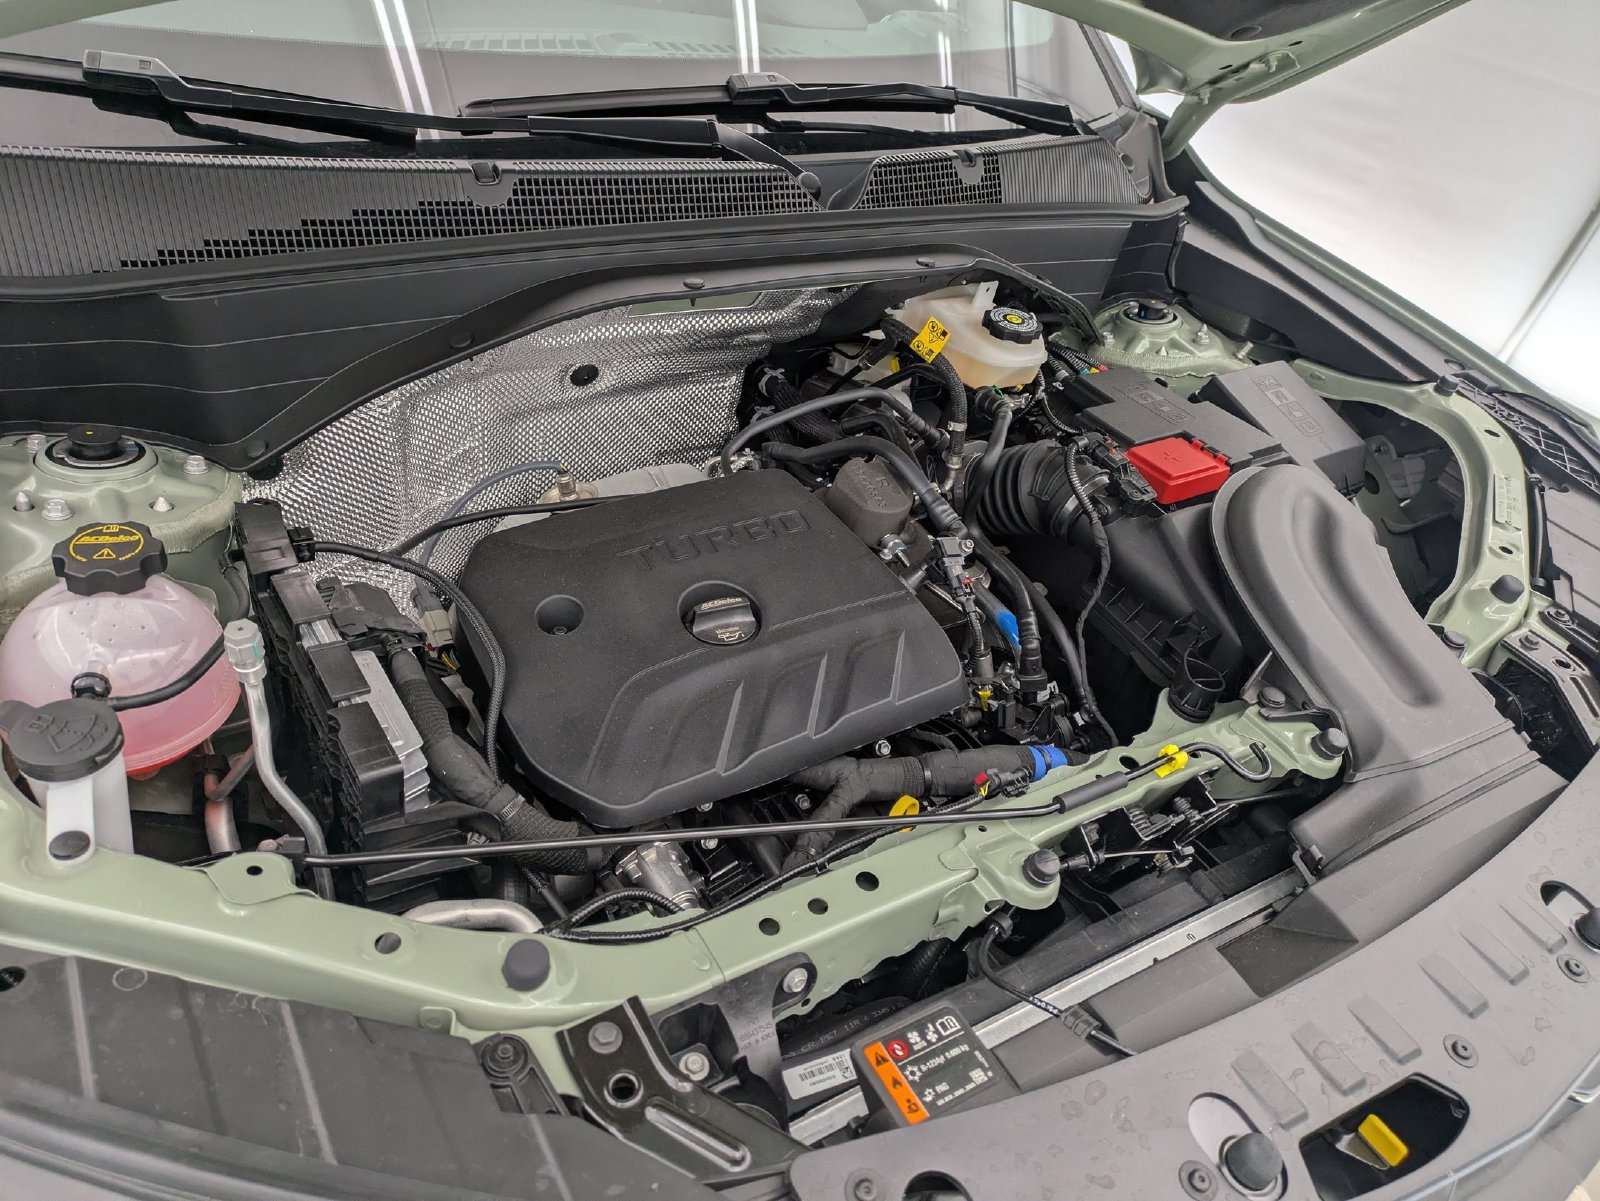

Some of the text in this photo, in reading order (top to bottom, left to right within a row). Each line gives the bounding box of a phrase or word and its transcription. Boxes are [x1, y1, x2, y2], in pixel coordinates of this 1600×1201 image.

[75, 535, 140, 544] ACDelco
[616, 509, 812, 570] TURBO
[701, 597, 742, 610] ACDelco
[920, 1054, 945, 1072] R-1234yf
[959, 1044, 970, 1052] kg
[935, 1081, 950, 1094] PAG
